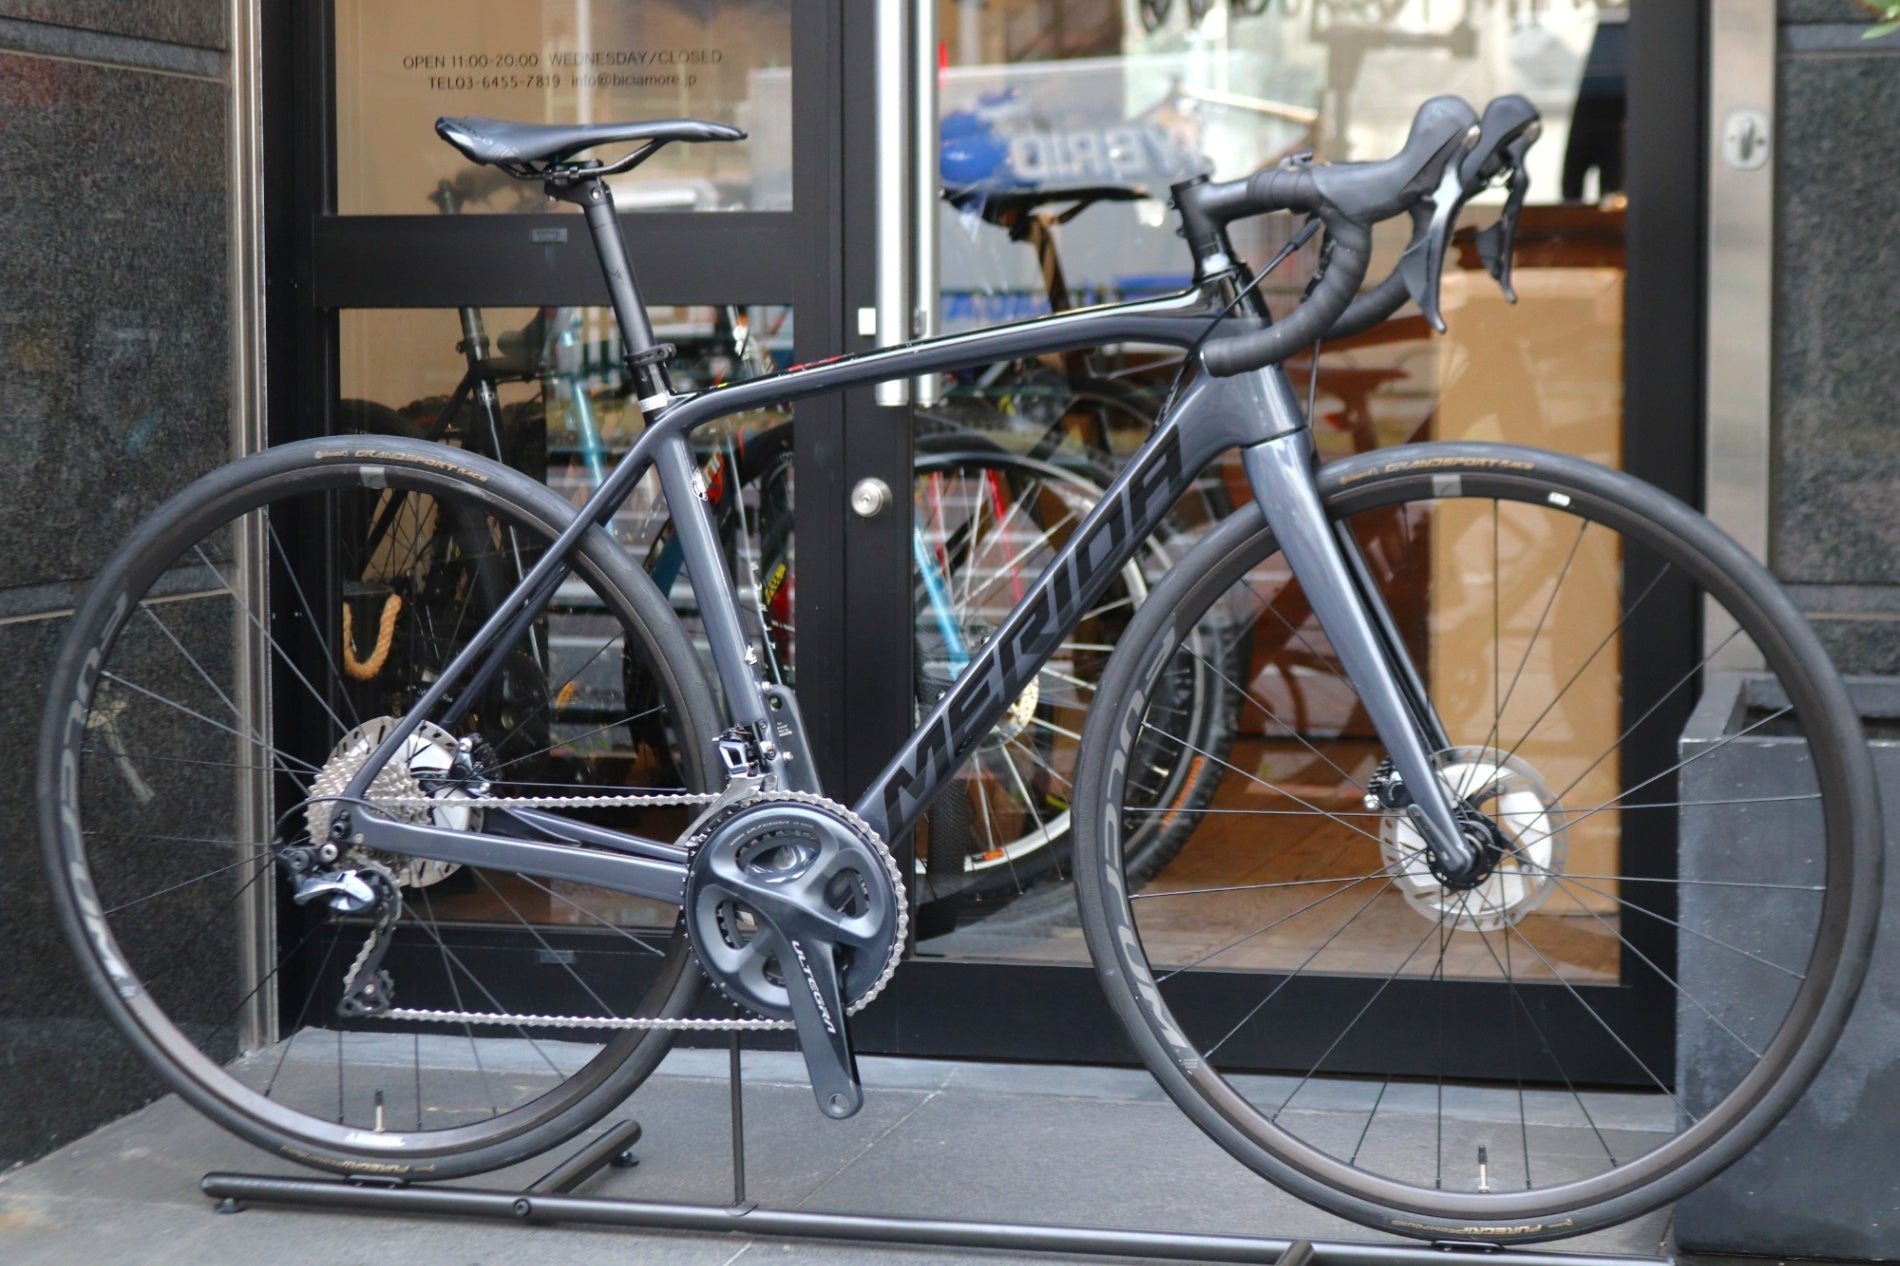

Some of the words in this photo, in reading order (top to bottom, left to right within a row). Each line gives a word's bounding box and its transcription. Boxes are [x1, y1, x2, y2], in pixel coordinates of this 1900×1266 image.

[403, 54, 446, 69] OPEN
[884, 423, 1183, 839] MERIDA
[792, 940, 837, 1034] ULTEGRA
